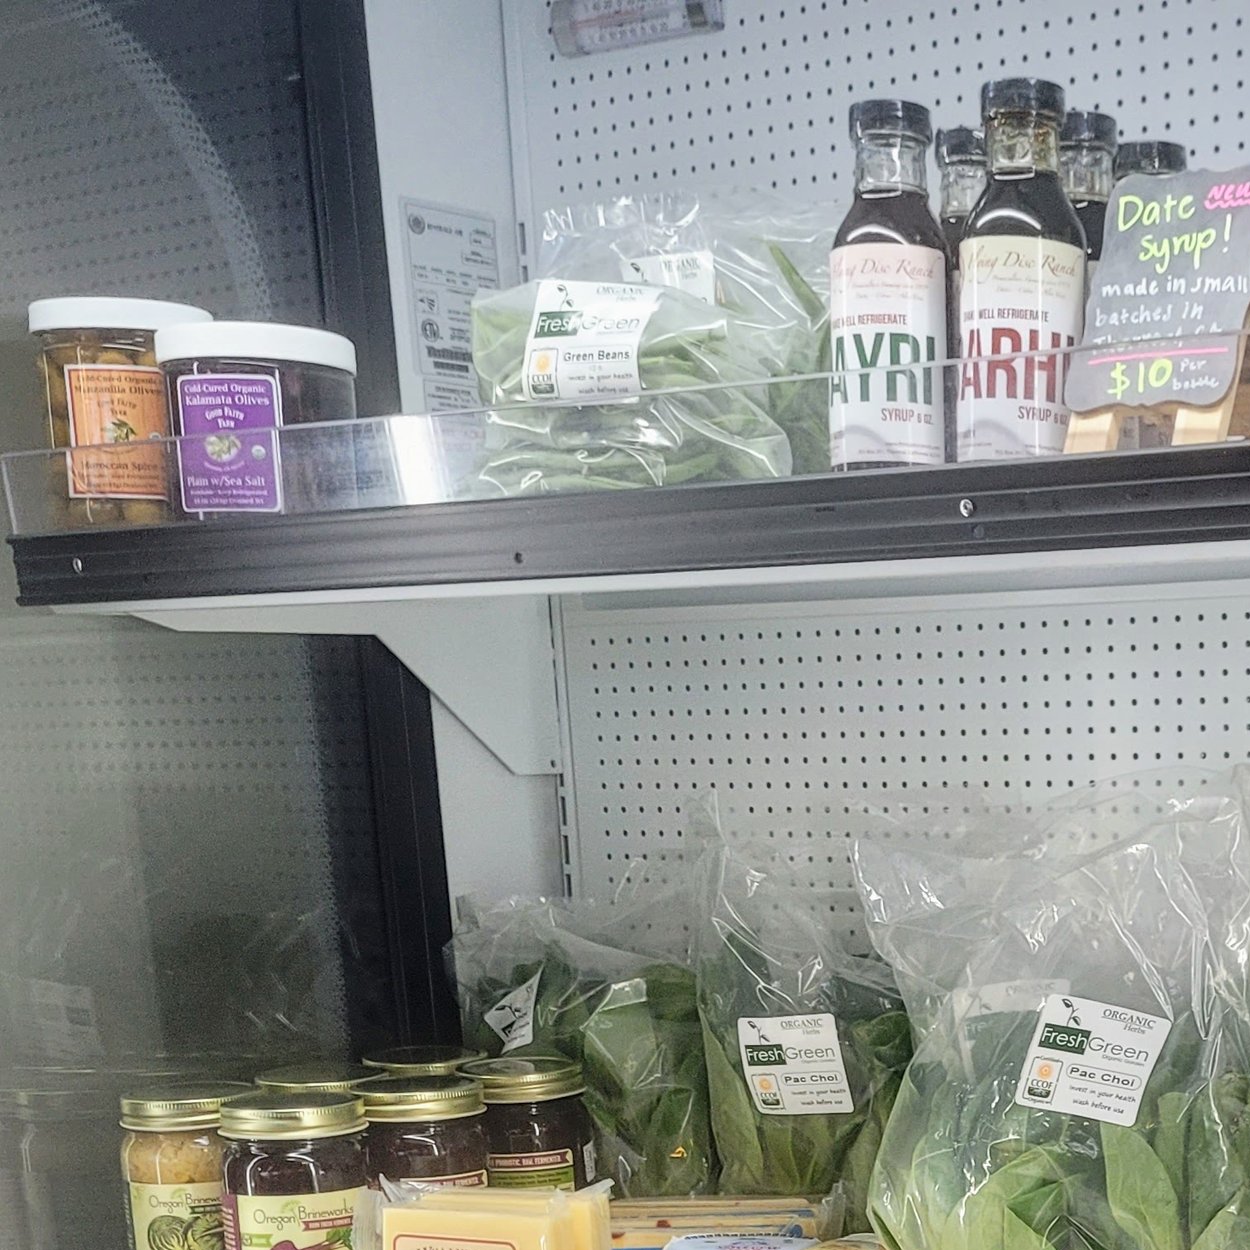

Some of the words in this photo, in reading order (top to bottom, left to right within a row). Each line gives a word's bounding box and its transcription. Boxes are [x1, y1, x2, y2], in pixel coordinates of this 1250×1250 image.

[1117, 194, 1195, 232] Date
[860, 259, 894, 275] Disc
[899, 258, 934, 280] Ranch
[1003, 250, 1036, 269] Disc
[1041, 252, 1076, 279] Ranch
[1102, 278, 1159, 297] made
[1167, 275, 1185, 294] in
[1191, 275, 1248, 295] small
[857, 314, 907, 326] REFRIGERATE
[997, 307, 1048, 322] REFRIGERATE
[1095, 304, 1172, 327] batches
[564, 351, 594, 362] Green
[598, 350, 630, 361] Beans
[1107, 358, 1173, 399] $10
[230, 384, 266, 395] Organic
[185, 394, 233, 406] Kalamata
[235, 395, 270, 405] Olives
[881, 408, 915, 422] SYRUP
[1017, 406, 1051, 420] SYRUP
[187, 475, 208, 487] Plain
[211, 475, 242, 488] w/Sea
[245, 475, 265, 487] Salt
[780, 1019, 823, 1030] ORGANIC
[1102, 1008, 1157, 1030] ORGANIC
[1069, 1067, 1096, 1079] Pac
[1101, 1074, 1135, 1087] Choi
[150, 1195, 183, 1213] Oregon
[253, 1209, 296, 1231] Oregon
[298, 1198, 353, 1226] Brineworks
